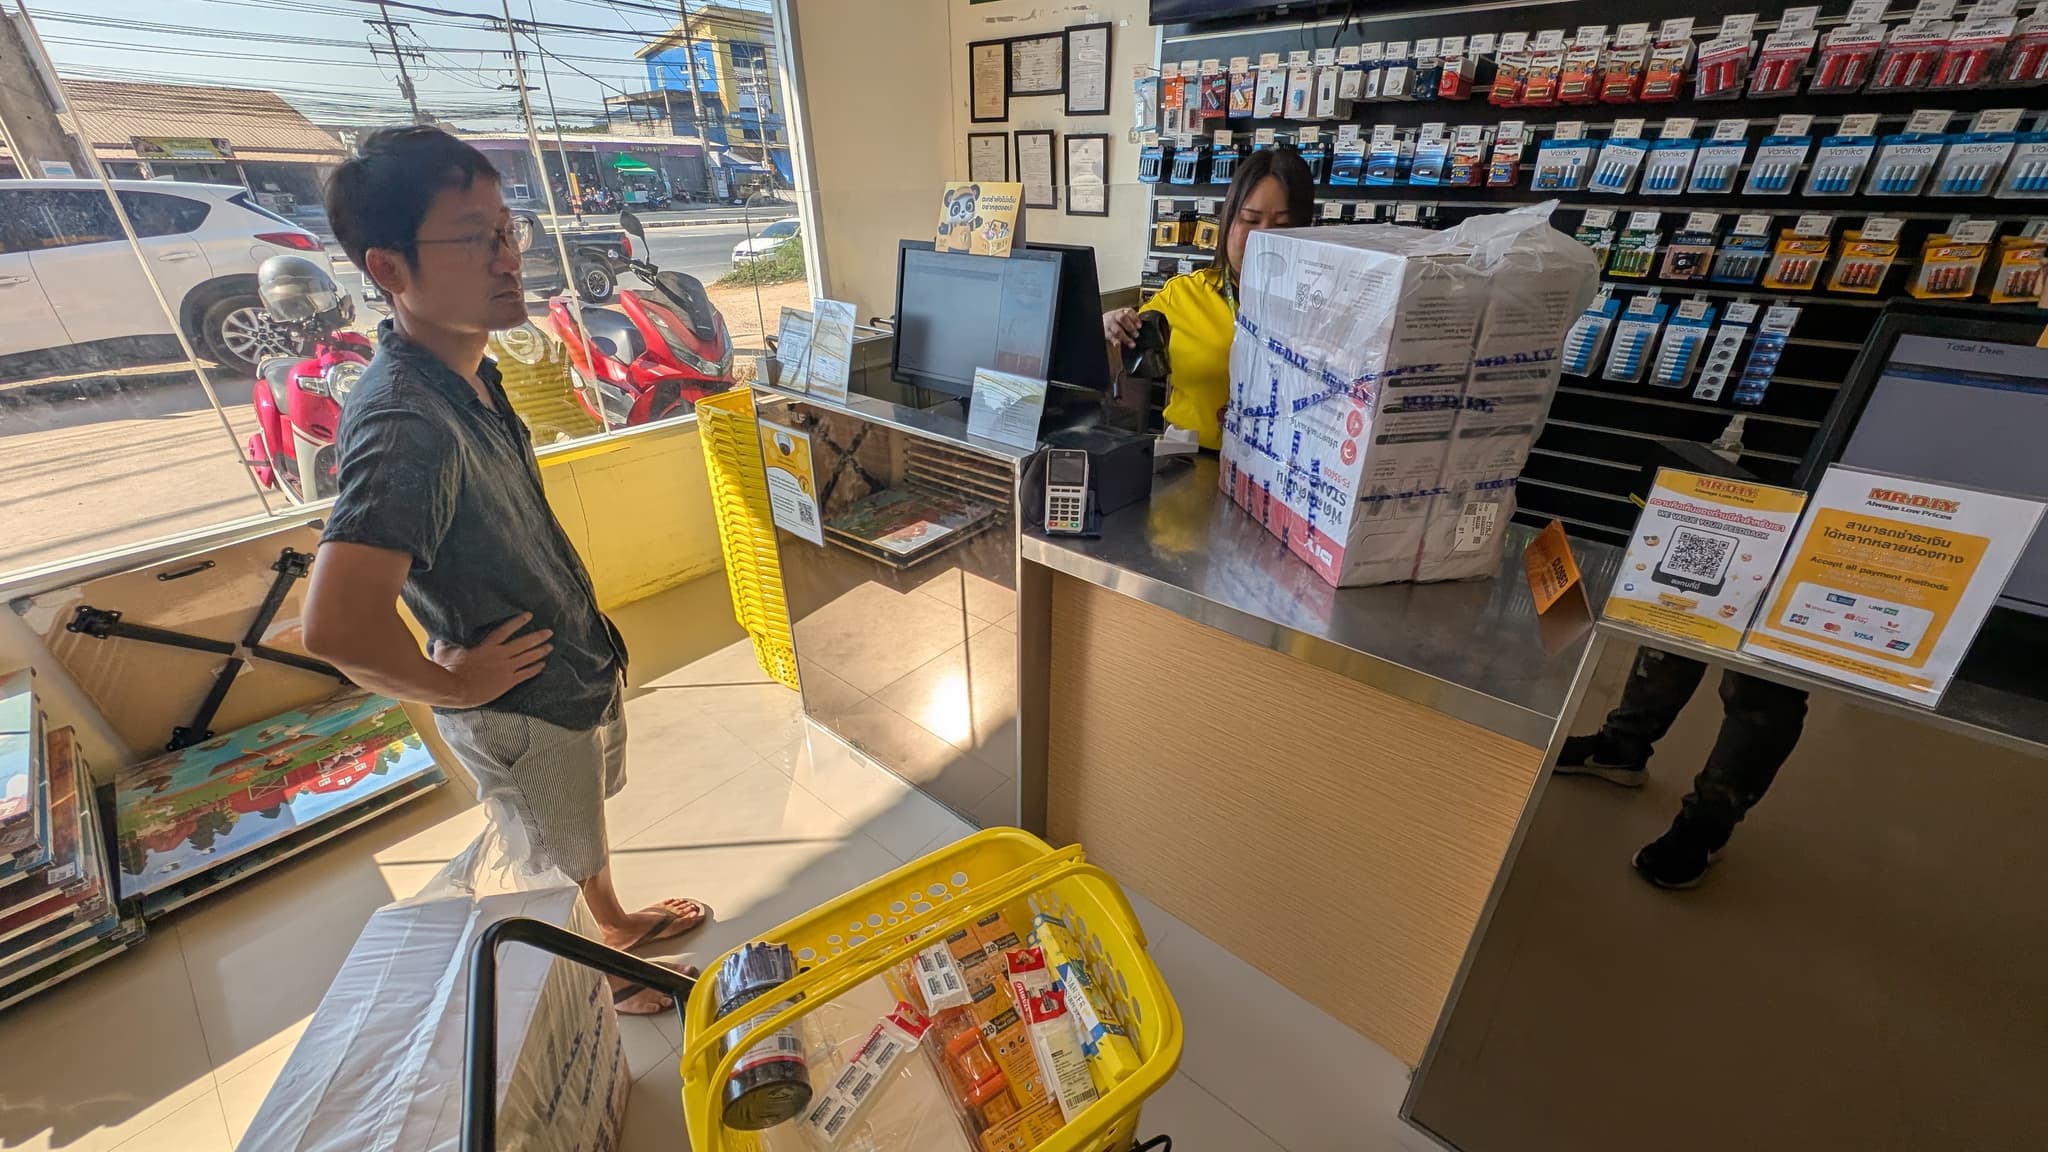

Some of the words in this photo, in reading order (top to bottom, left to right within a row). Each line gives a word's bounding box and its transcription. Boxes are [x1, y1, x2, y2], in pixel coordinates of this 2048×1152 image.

[1947, 342, 1976, 352] Total
[1976, 345, 2004, 355] Due
[1657, 509, 1671, 518] WE
[1672, 513, 1698, 524] VALUE
[1699, 518, 1722, 530] YOUR
[1723, 523, 1769, 540] FEEDBACK
[1865, 500, 1900, 512] Always
[1901, 506, 1920, 515] Low
[1921, 510, 1952, 521] Prices
[1823, 526, 1965, 564] ได้หลากหลายช่องทาง
[1845, 520, 1952, 548] สามารถชำระเงิน
[1552, 557, 1569, 588] CLOSED
[1810, 555, 1843, 569] Accept
[1845, 562, 1857, 571] all
[1858, 566, 1902, 581] payment
[1904, 574, 1949, 591] methods
[1853, 631, 1874, 641] VISA
